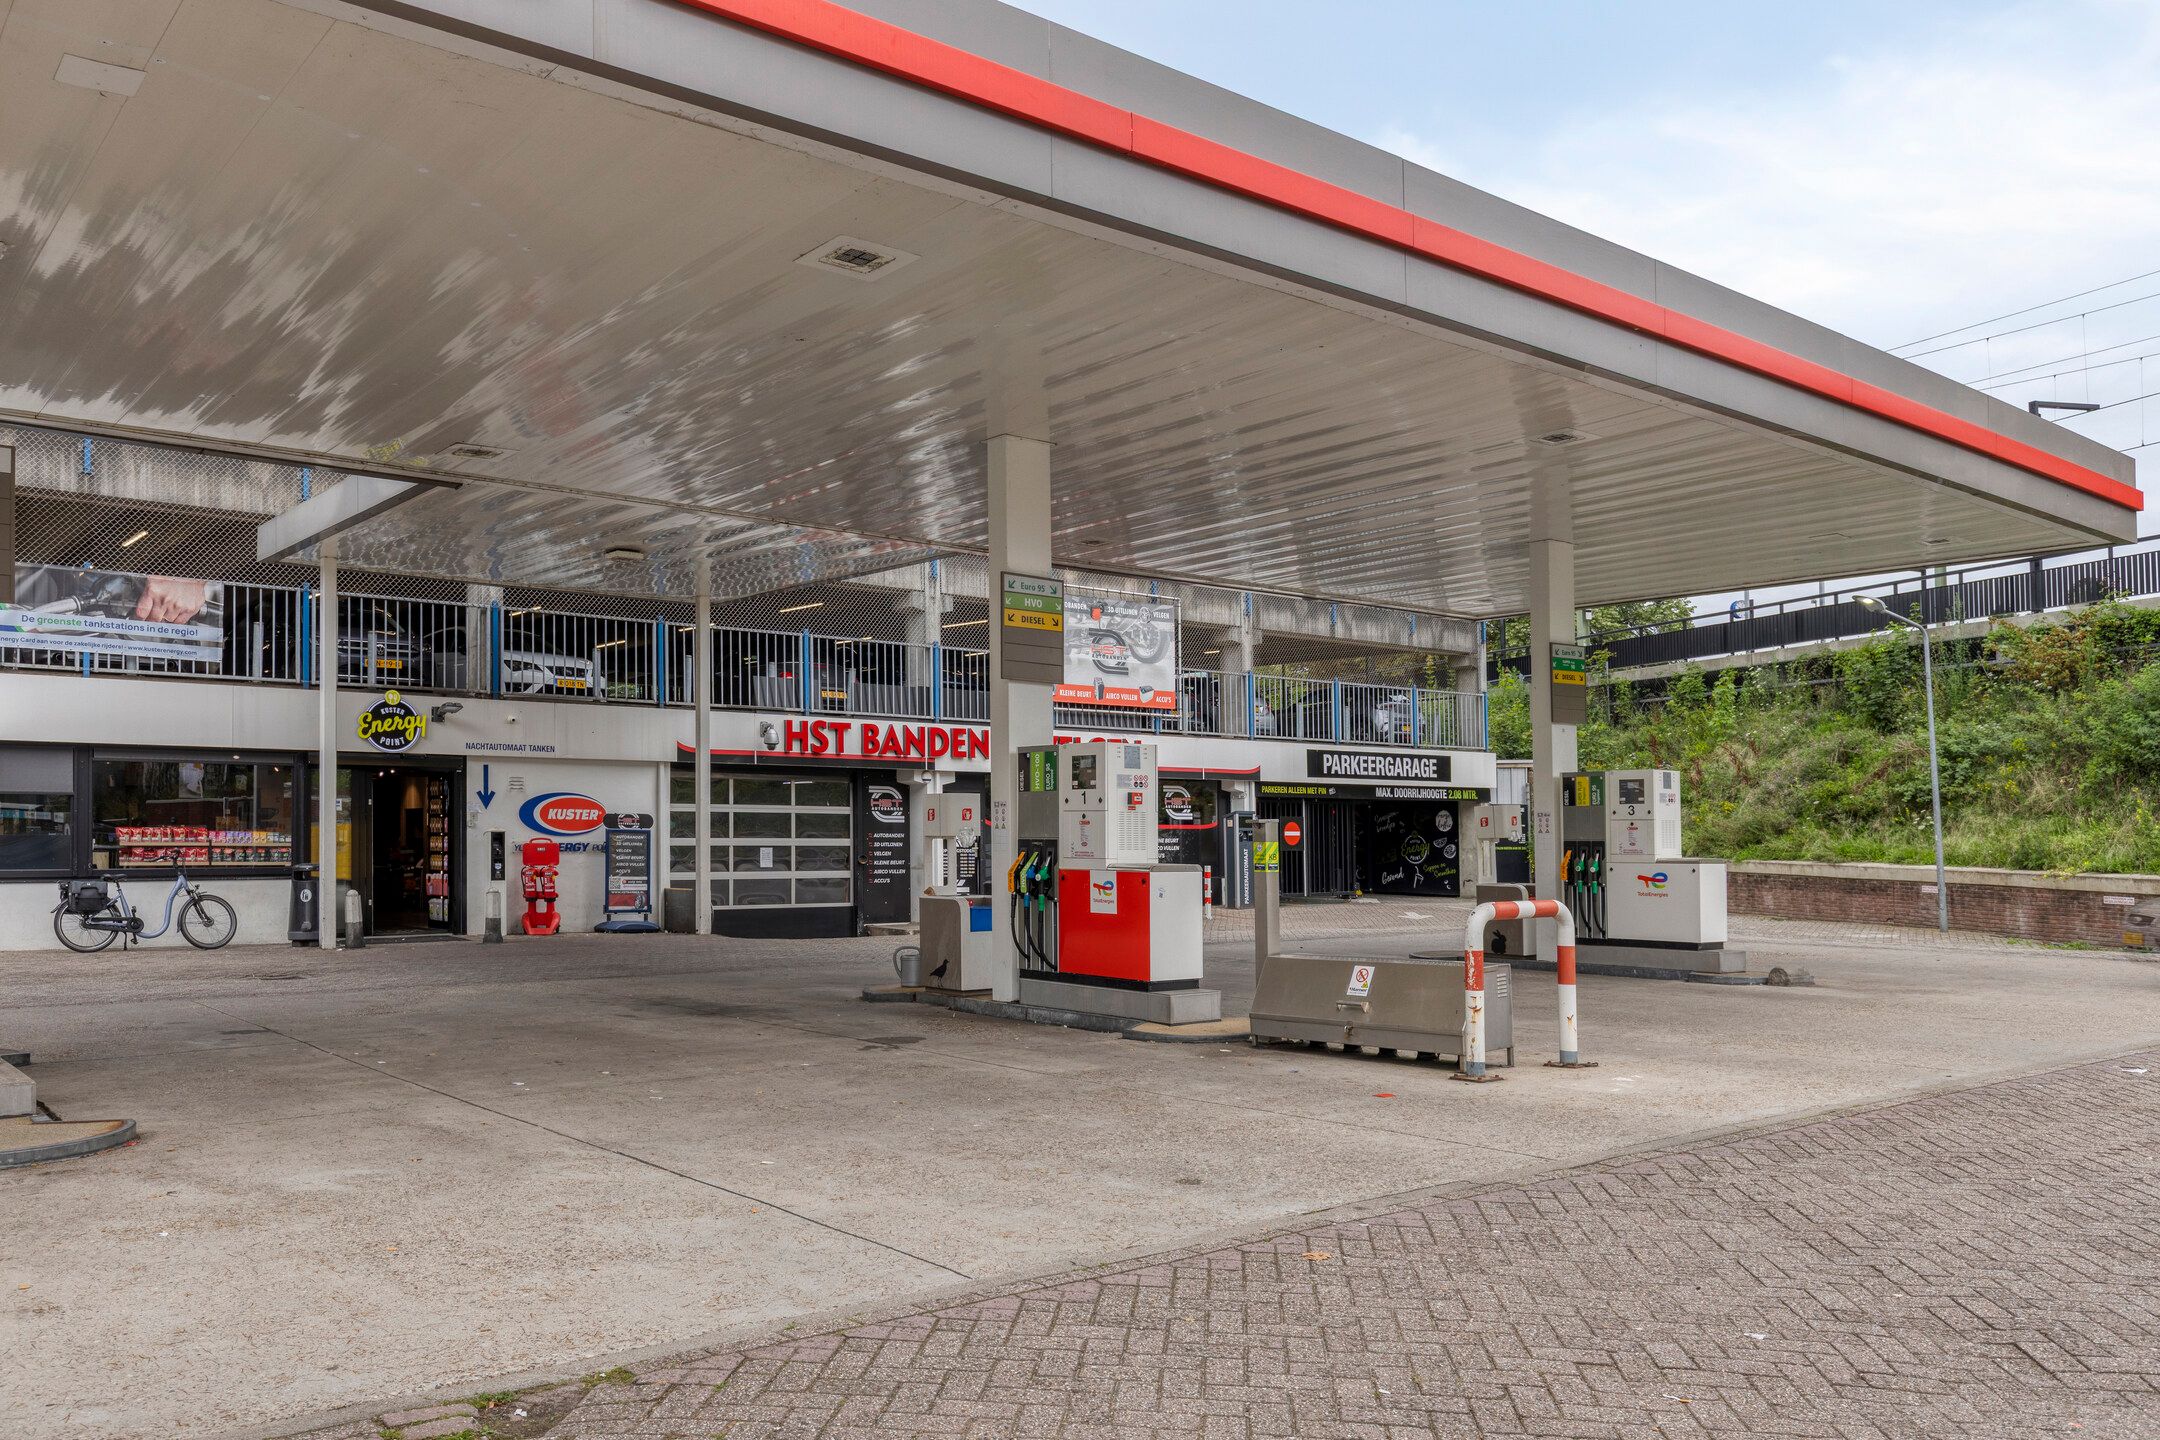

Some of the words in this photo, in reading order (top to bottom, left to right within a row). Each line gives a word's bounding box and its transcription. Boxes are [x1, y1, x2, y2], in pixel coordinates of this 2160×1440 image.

[1020, 581, 1036, 592] Euro
[1037, 584, 1046, 593] 95
[1024, 597, 1043, 609] HVO
[1021, 615, 1046, 626] DIESEL
[1153, 611, 1170, 619] VELGEN
[21, 614, 35, 623] De
[36, 616, 82, 627] groenste
[84, 618, 145, 632] tankstations
[146, 624, 156, 633] in
[157, 625, 169, 634] de
[171, 626, 198, 638] regio!
[74, 640, 101, 650] zakelijke
[1059, 689, 1076, 698] KLEINE
[1076, 690, 1092, 699] BEURT
[1106, 692, 1121, 701] AIRCO
[1121, 693, 1139, 702] VULLEN
[1155, 695, 1172, 704] ACCU'S
[357, 711, 428, 742] Energy
[379, 736, 406, 748] POINT
[784, 719, 852, 755] HST
[861, 723, 990, 760] BANDEN
[465, 742, 527, 752] NACHTAUTOMAAT
[529, 744, 556, 754] TANKEN
[1322, 753, 1438, 778] PARKEERGARAGE
[1261, 785, 1288, 795] PARKEREN
[1287, 786, 1307, 796] ALLEEN
[1307, 786, 1318, 796] MET
[1318, 787, 1327, 797] PIN
[1375, 786, 1394, 799] MAX.
[1394, 787, 1448, 800] DOORRIJHOOGTE
[1448, 789, 1462, 800] 2.08
[1462, 790, 1479, 801] MTR.
[1081, 790, 1087, 806] 1
[547, 808, 599, 821] KUSTER
[1627, 804, 1636, 817] 3
[1400, 842, 1430, 858] Energy
